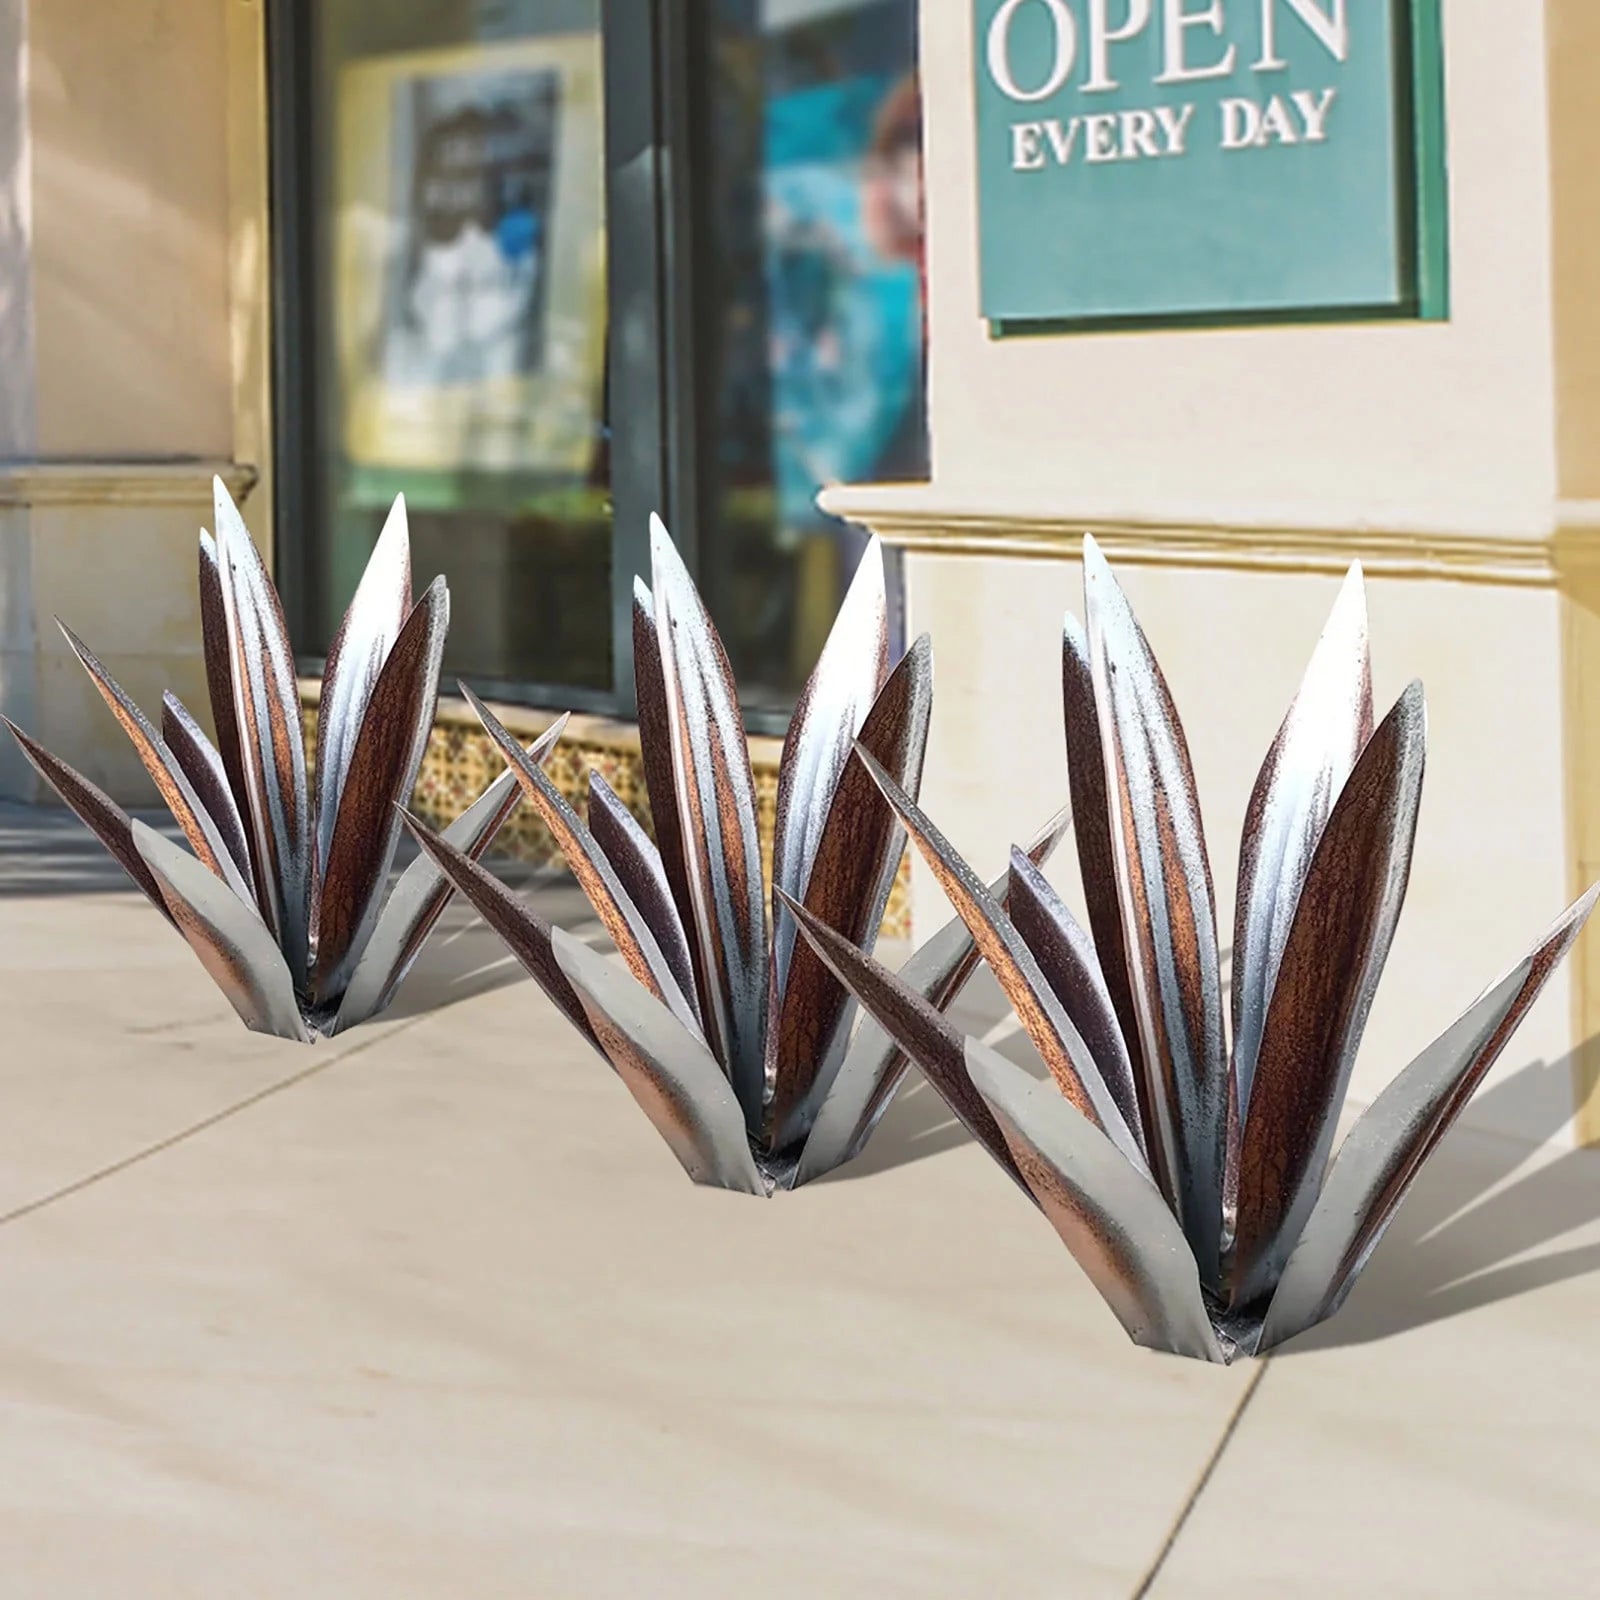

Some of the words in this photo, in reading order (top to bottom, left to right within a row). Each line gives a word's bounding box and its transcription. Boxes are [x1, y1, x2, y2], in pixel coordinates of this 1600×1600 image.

[988, 0, 1347, 102] OPEN
[1011, 104, 1193, 170] EVERY
[1220, 88, 1335, 149] DAY
